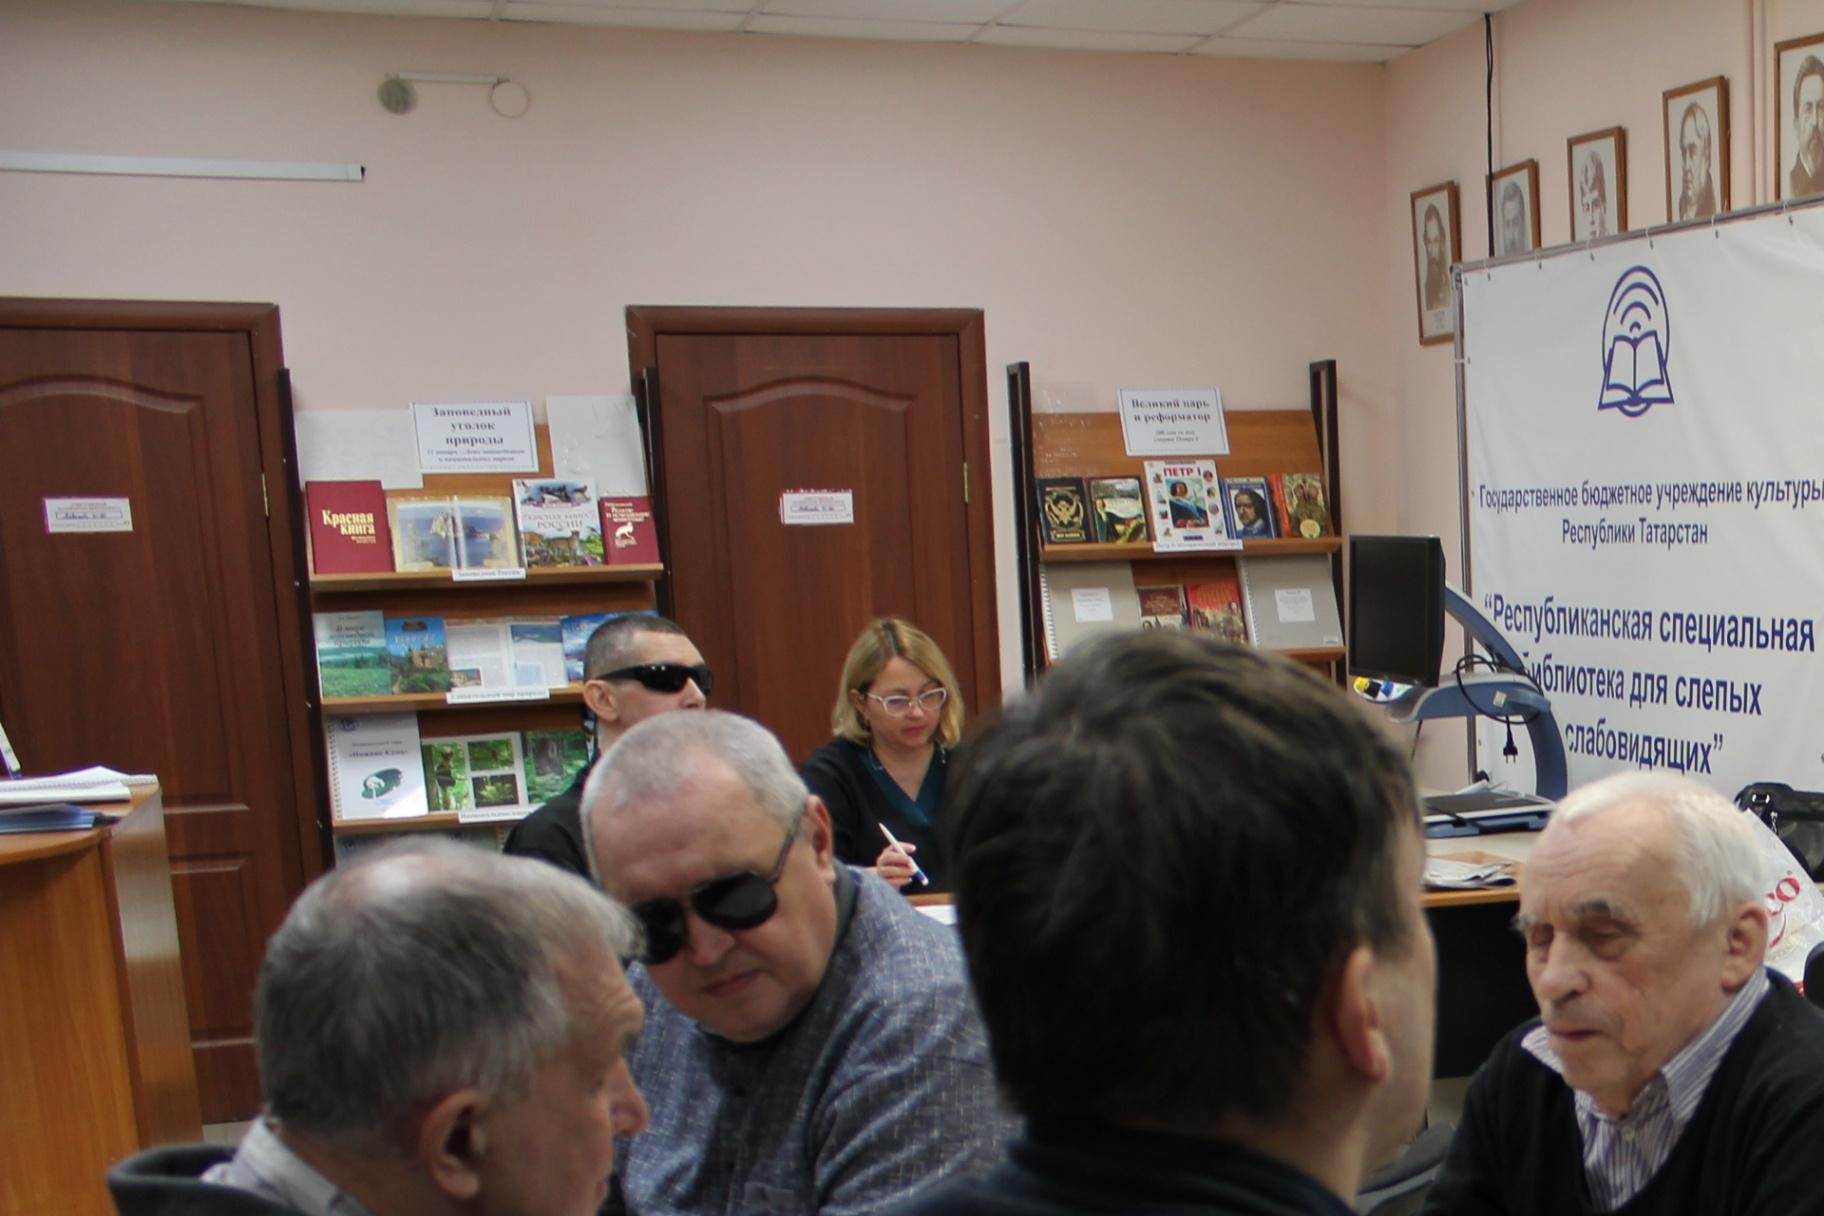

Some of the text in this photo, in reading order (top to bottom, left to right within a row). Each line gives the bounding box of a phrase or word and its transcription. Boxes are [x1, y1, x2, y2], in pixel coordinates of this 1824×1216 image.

[1132, 399, 1210, 409] Великий царь
[433, 407, 511, 417] Заповедный
[1134, 412, 1211, 424] и реформатор
[450, 422, 496, 432] уголок
[445, 436, 504, 447] природы
[1163, 467, 1194, 477] ПЕТР
[1479, 485, 1578, 514] Государственное
[1581, 480, 1653, 510] бюджетное
[1656, 480, 1743, 510] учреждение
[321, 509, 374, 528] Красная
[537, 520, 584, 529] РОССИИ
[340, 523, 376, 536] книга
[1562, 517, 1709, 550] Республики Татарстан
[1659, 610, 1816, 653] специальная
[1629, 670, 1668, 709] для
[1675, 674, 1763, 716] слепых
